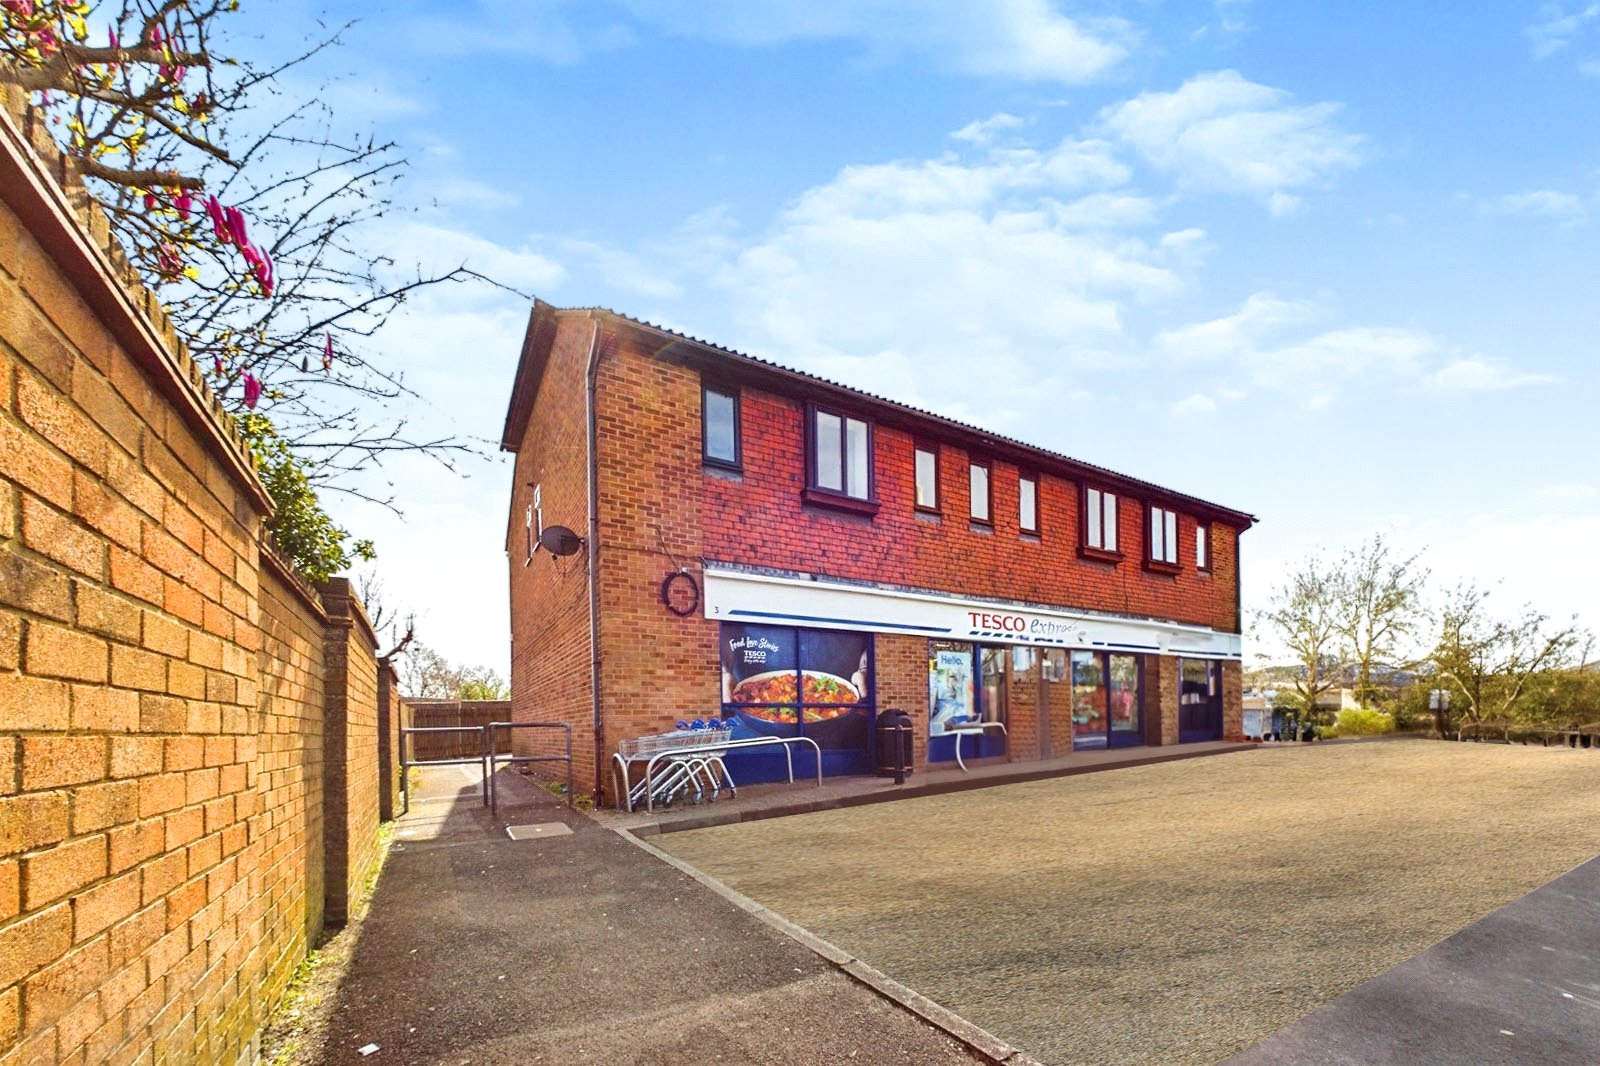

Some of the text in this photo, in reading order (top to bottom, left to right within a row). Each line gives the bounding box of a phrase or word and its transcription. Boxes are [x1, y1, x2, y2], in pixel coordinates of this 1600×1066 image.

[714, 606, 719, 614] 3
[968, 612, 1078, 635] TESCO expr
[729, 636, 779, 652] Food Love Stories
